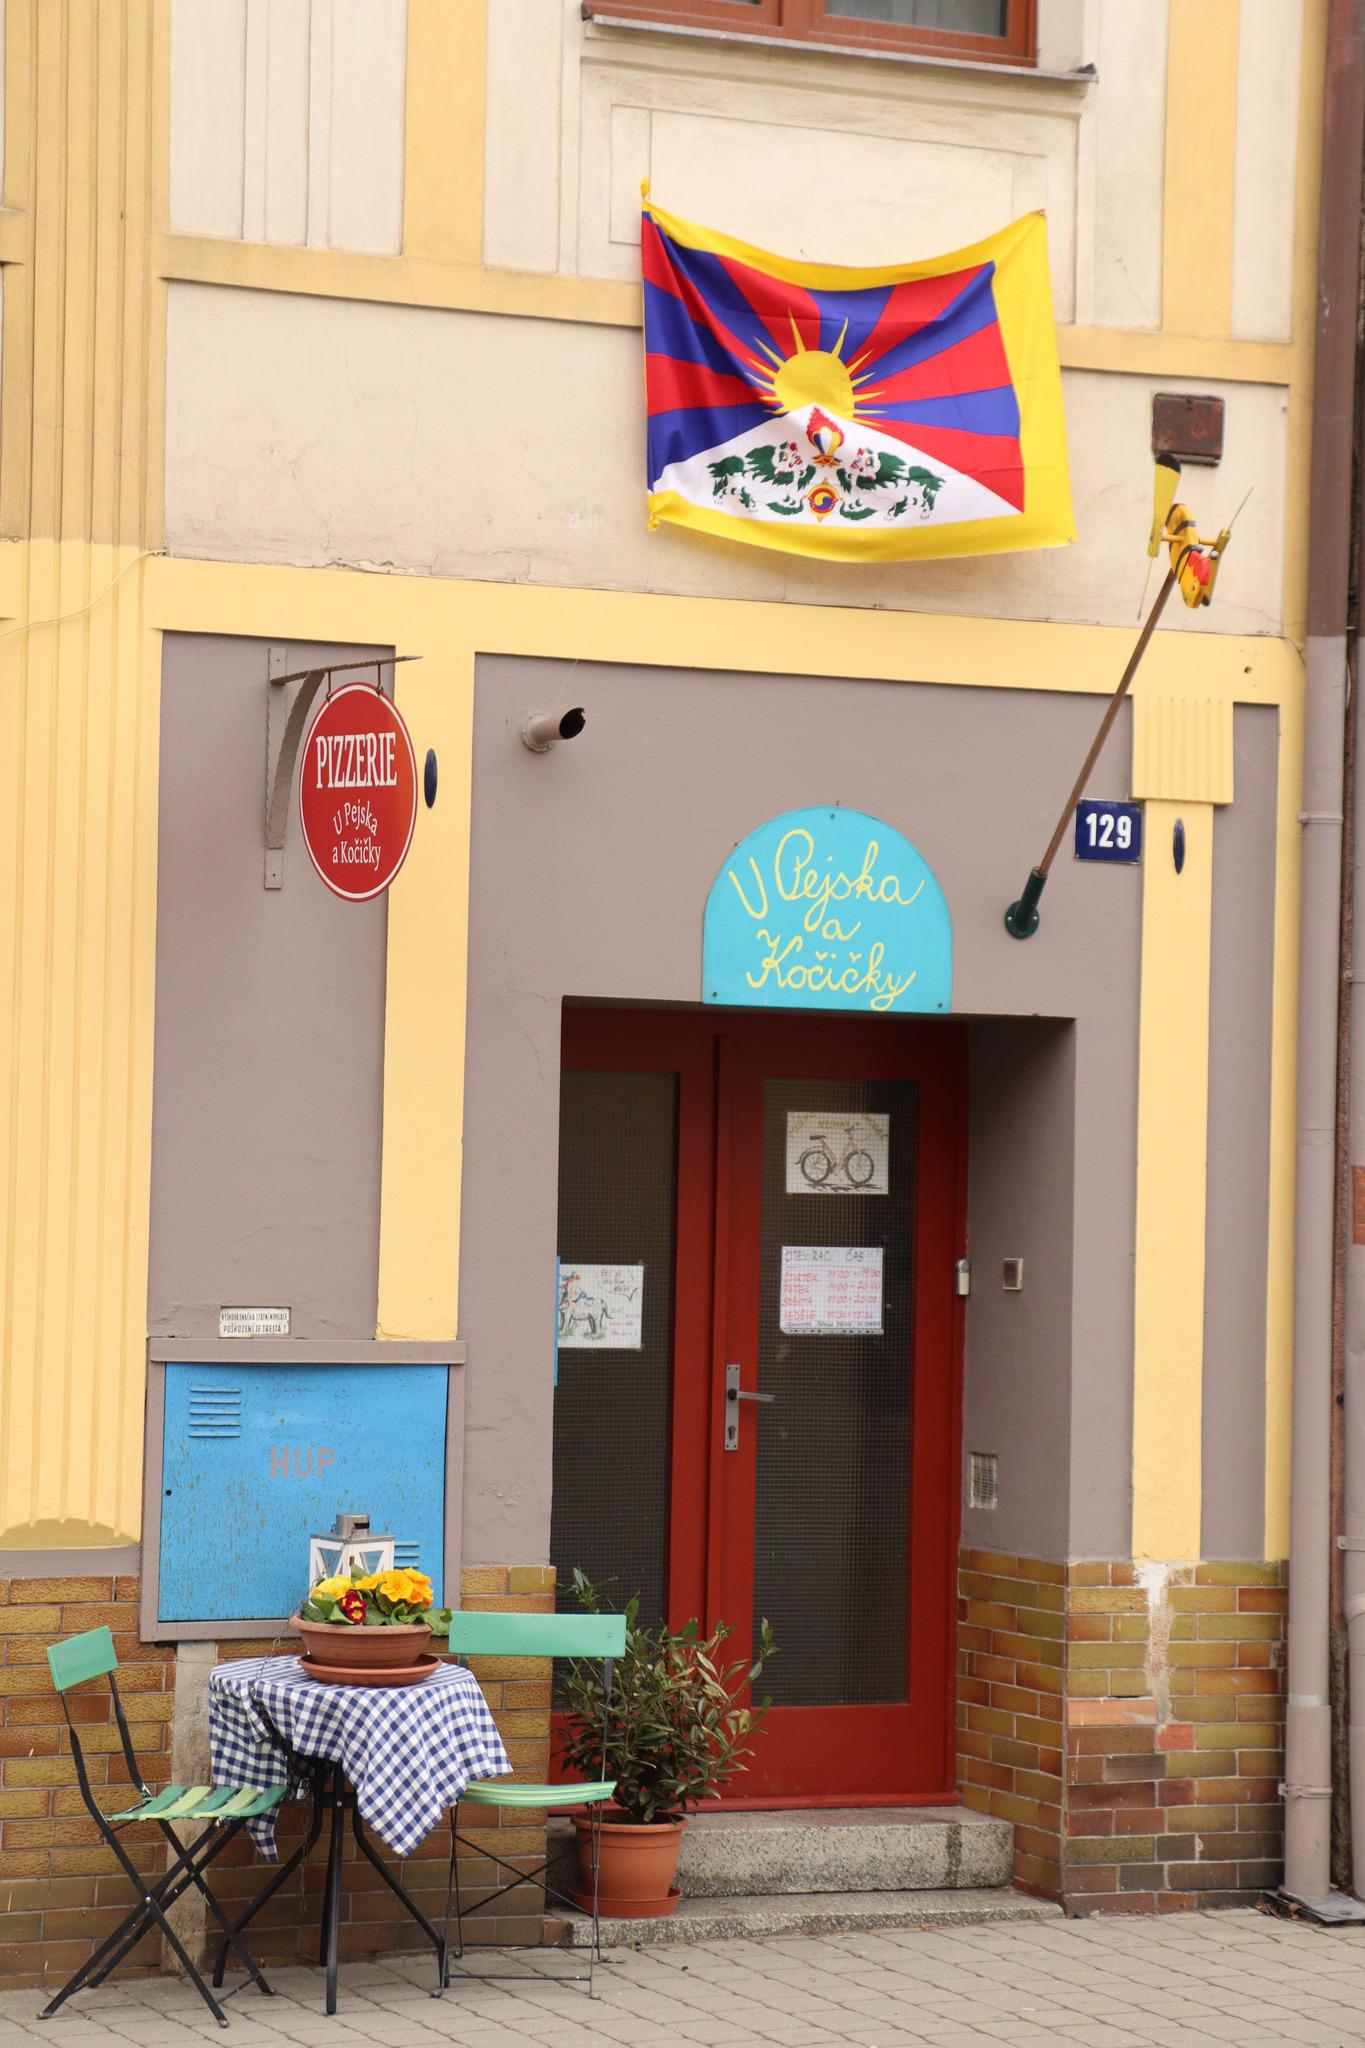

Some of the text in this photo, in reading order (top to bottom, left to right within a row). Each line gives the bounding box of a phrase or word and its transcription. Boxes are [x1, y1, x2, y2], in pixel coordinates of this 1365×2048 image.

[316, 732, 397, 789] PIZZERIE
[333, 799, 378, 836] U Pejska
[1085, 812, 1132, 849] 129
[332, 837, 381, 871] a Kočičky
[728, 828, 926, 932] U Pejska
[821, 918, 861, 941] a
[745, 928, 917, 1011] Kočičky
[845, 1249, 865, 1262] ČAS
[271, 1445, 335, 1480] HUP
